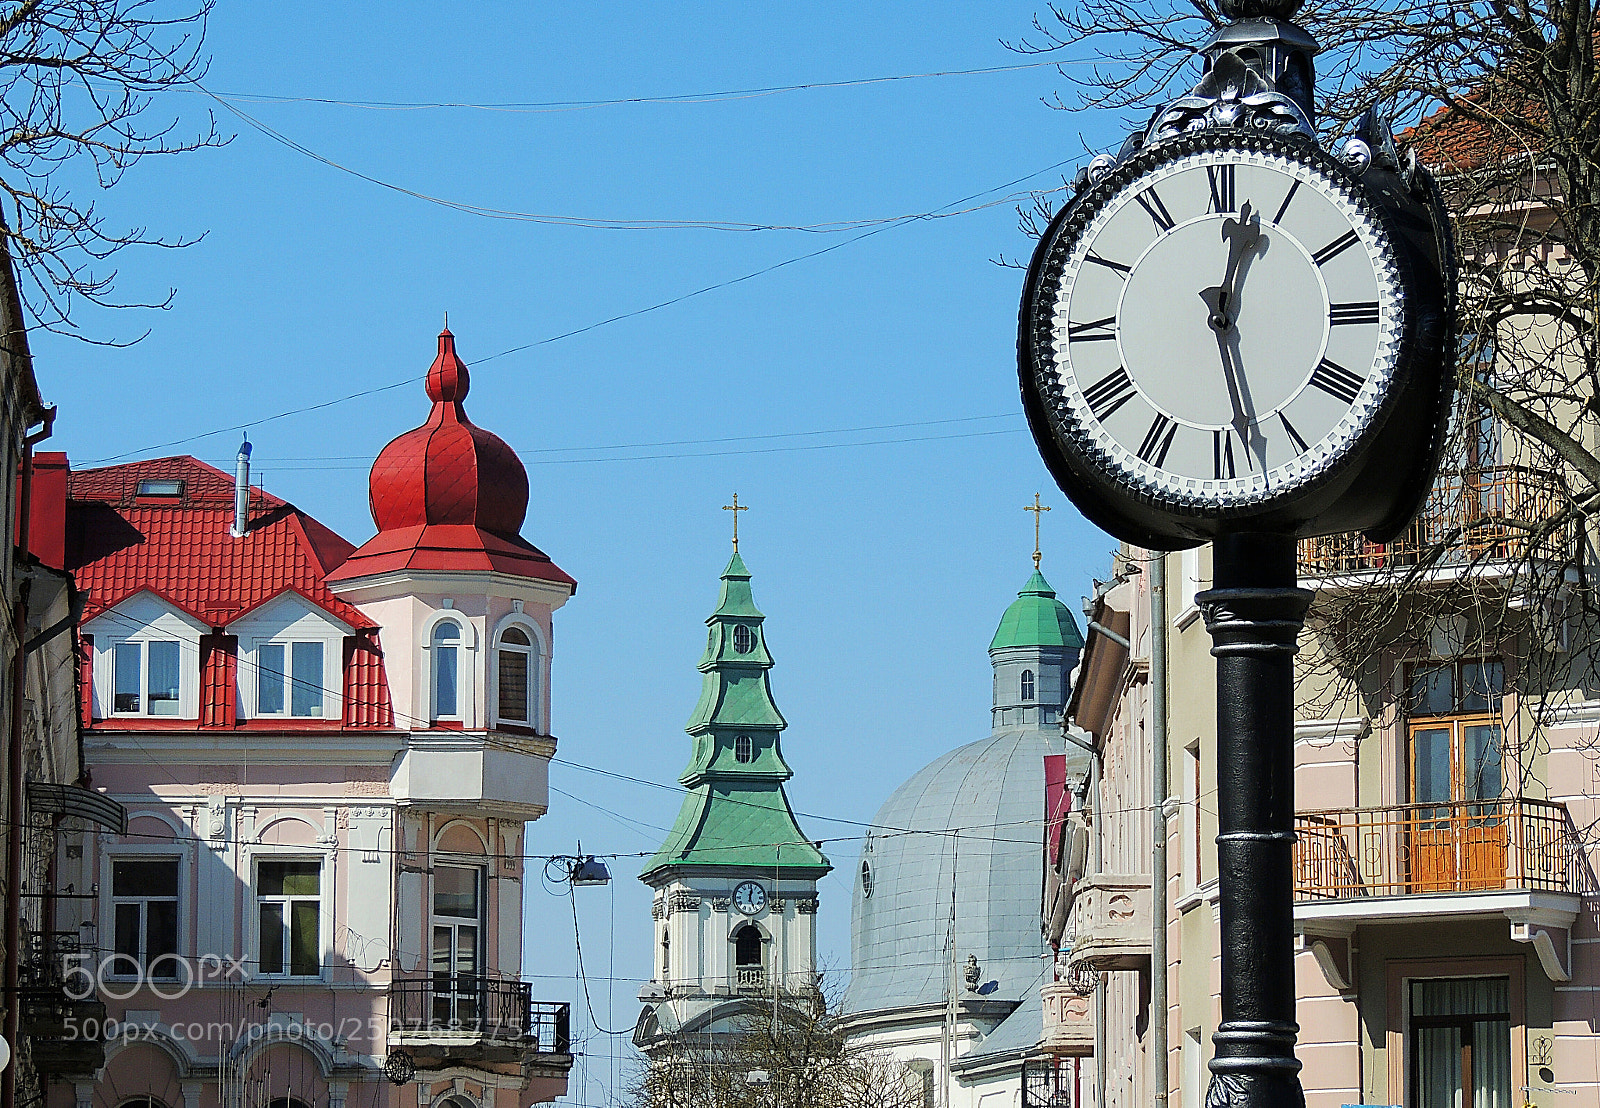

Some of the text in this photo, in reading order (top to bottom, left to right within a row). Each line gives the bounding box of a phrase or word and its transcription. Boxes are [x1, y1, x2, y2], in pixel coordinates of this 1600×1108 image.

[1134, 186, 1174, 236] XI
[1206, 165, 1236, 215] XII
[1273, 179, 1301, 225] I
[1084, 247, 1132, 281] X
[1312, 229, 1361, 266] II
[1068, 315, 1116, 342] IX
[1329, 302, 1380, 326] III
[1136, 413, 1179, 468] VII
[1213, 430, 1236, 480] VI
[1278, 411, 1309, 456] V
